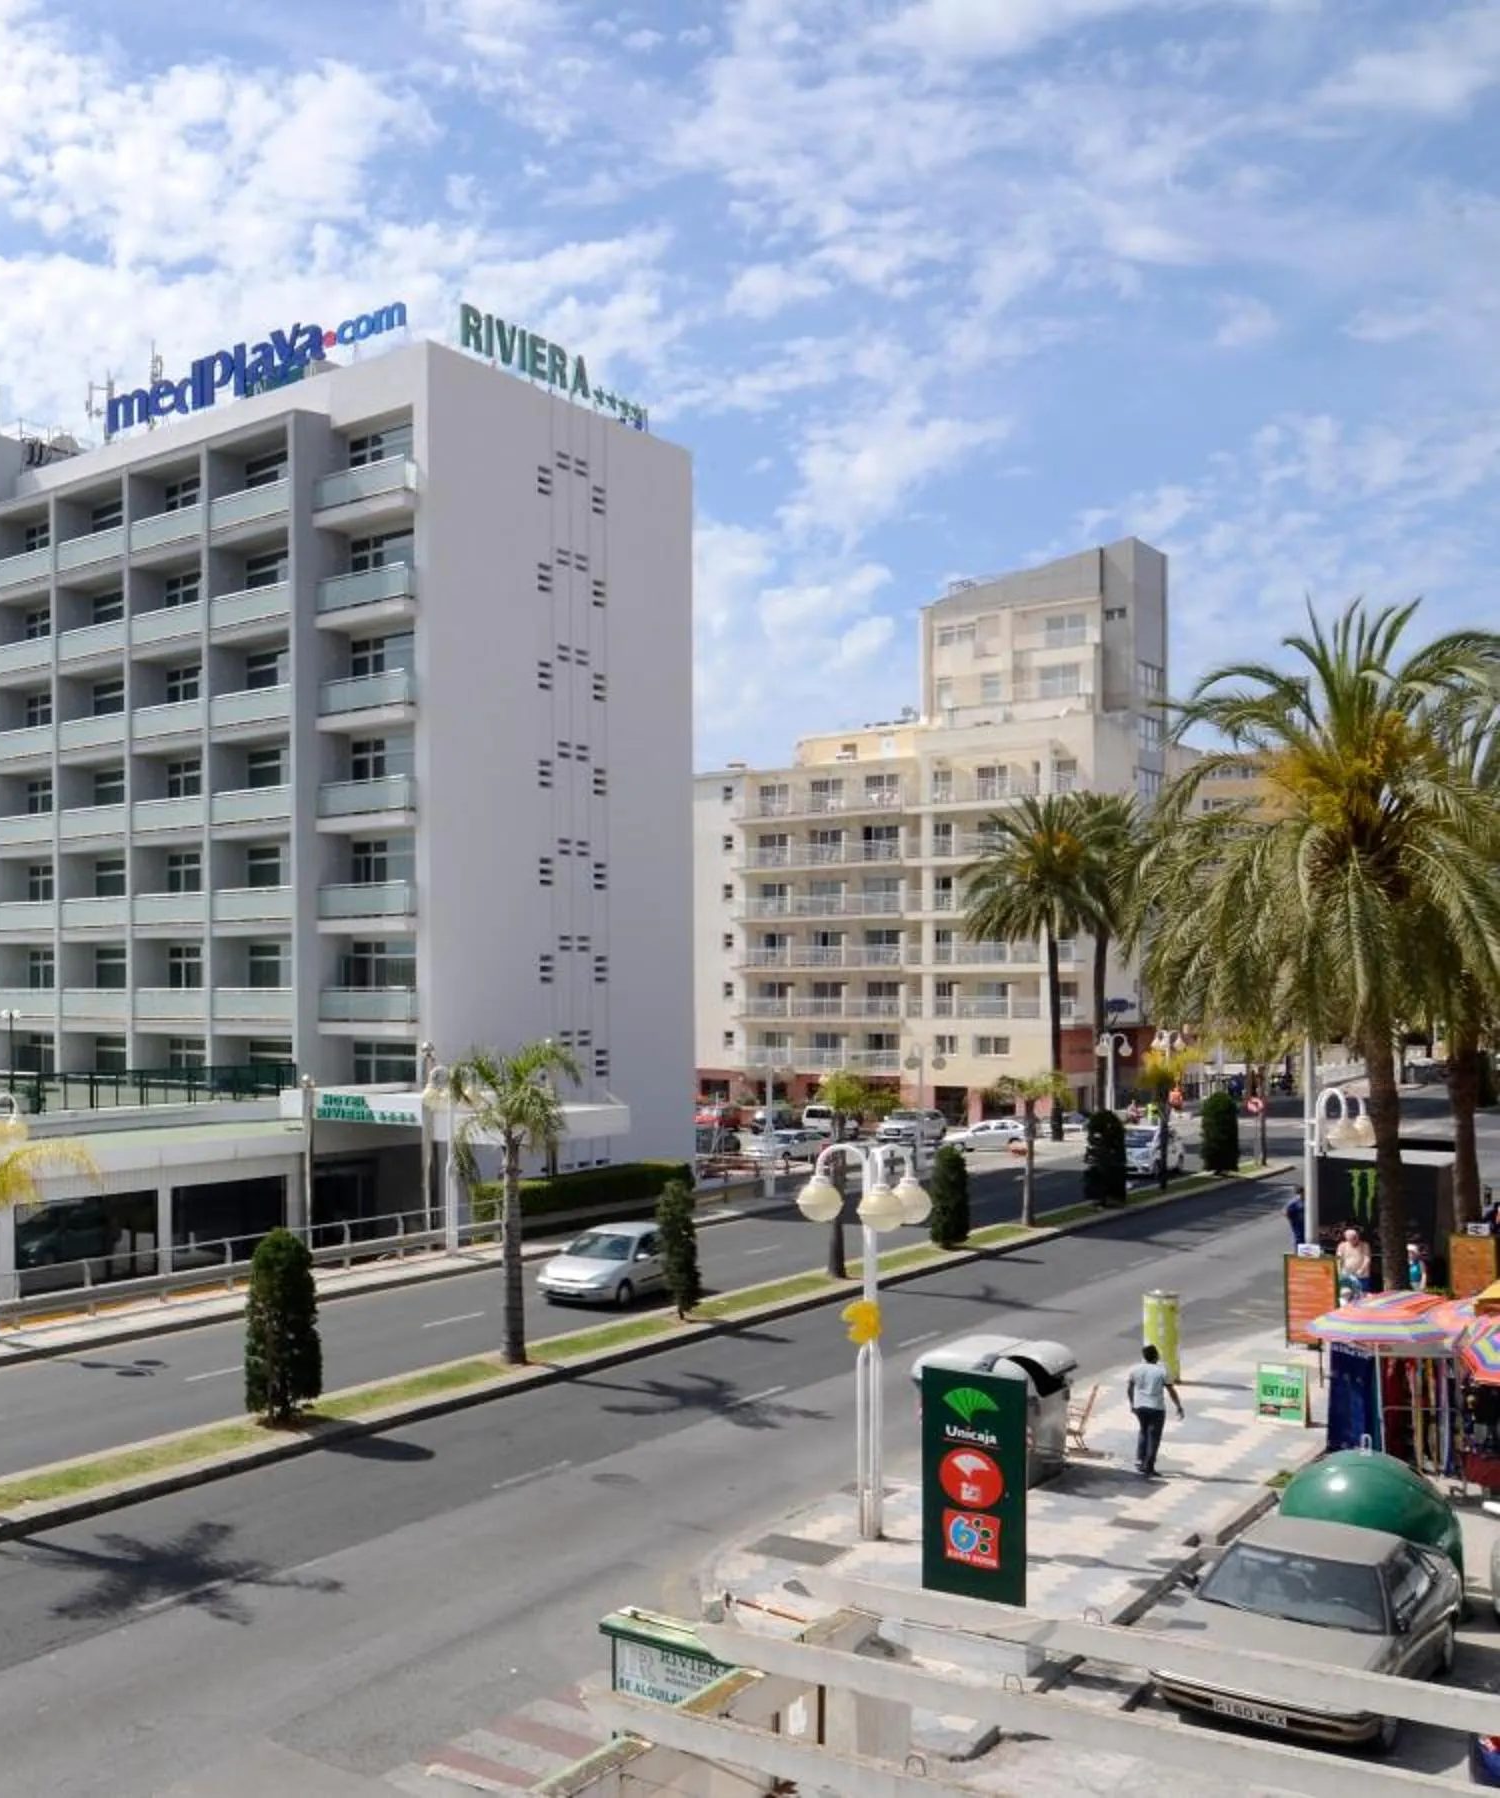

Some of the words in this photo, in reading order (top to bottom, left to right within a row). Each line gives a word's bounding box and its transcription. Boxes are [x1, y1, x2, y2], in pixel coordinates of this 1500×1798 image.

[459, 303, 590, 399] RIVIERA
[316, 1107, 375, 1122] RIVIERA
[945, 1423, 998, 1445] Unicaja
